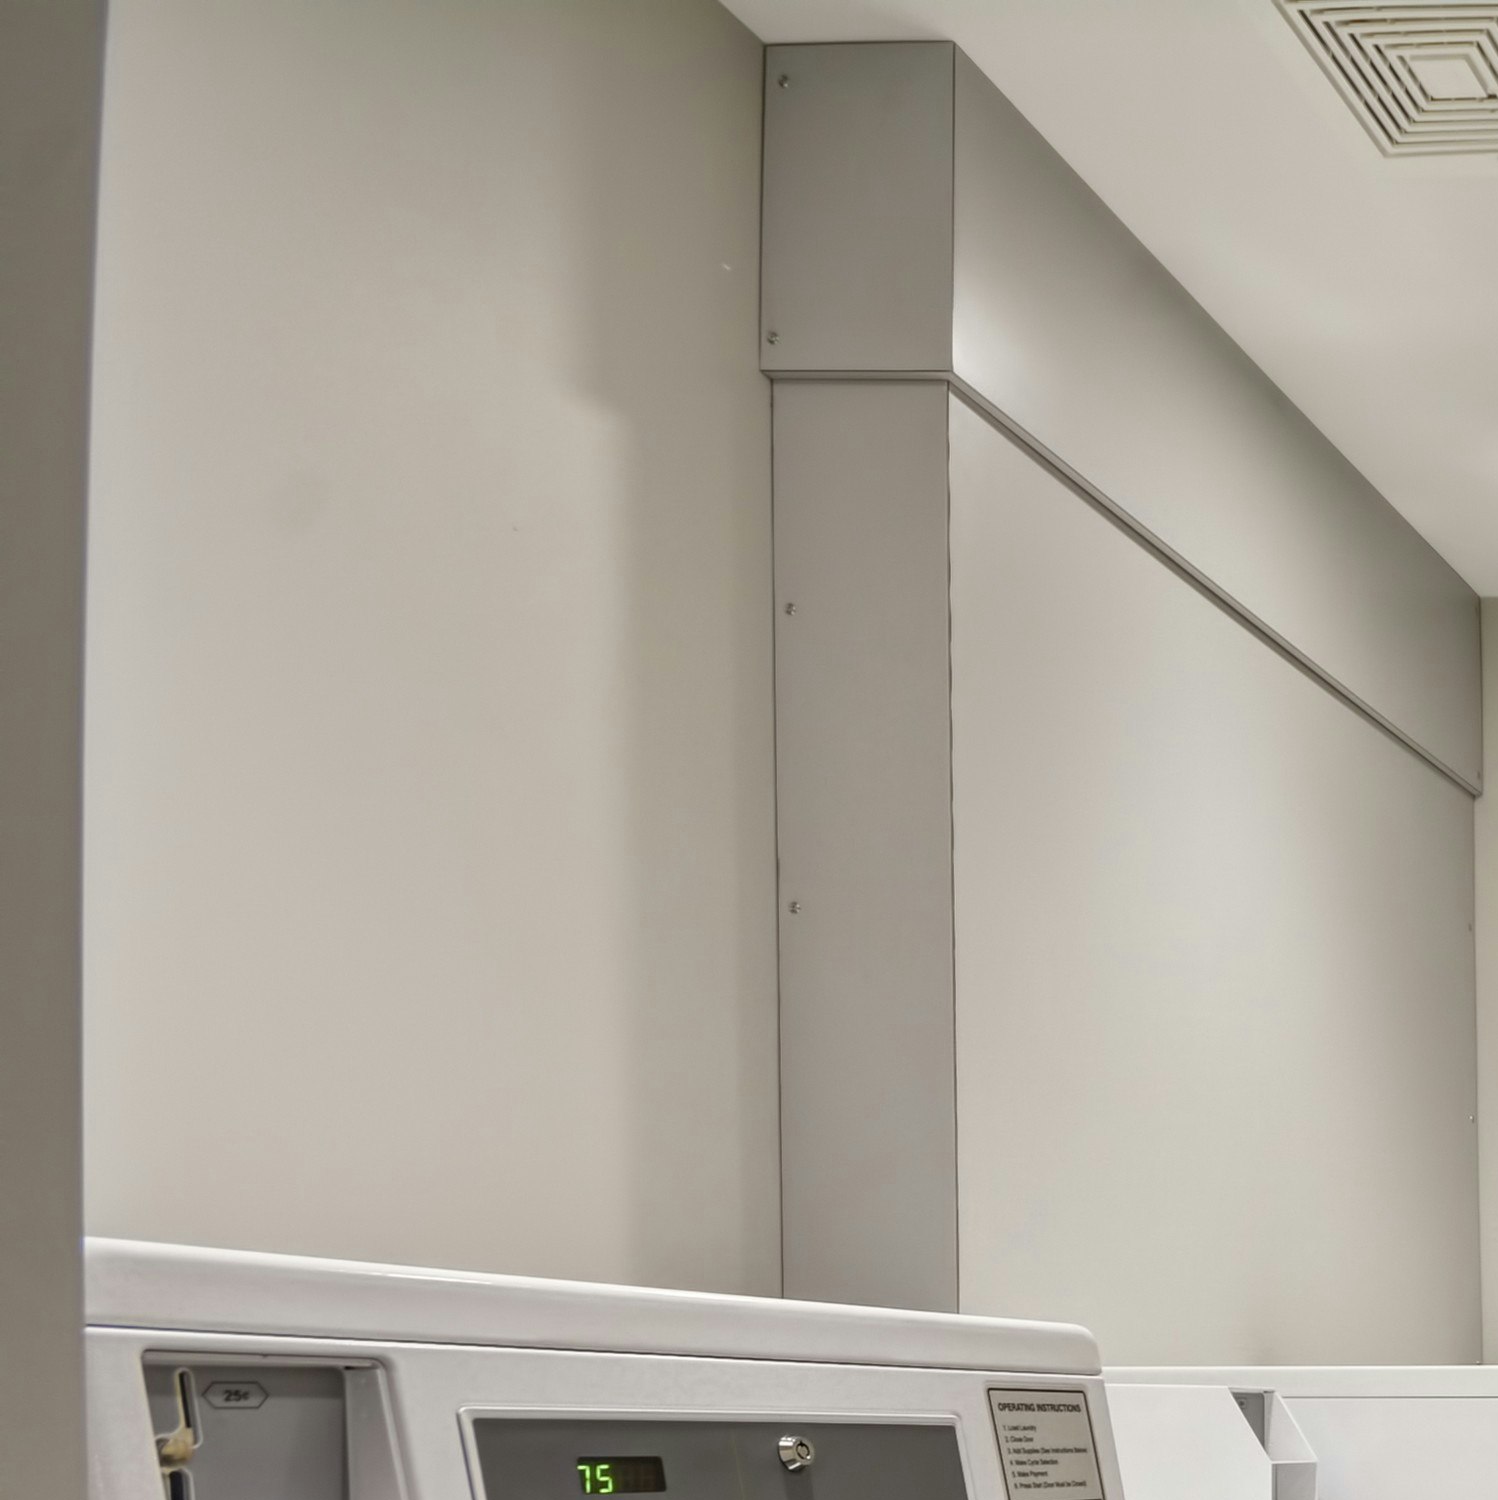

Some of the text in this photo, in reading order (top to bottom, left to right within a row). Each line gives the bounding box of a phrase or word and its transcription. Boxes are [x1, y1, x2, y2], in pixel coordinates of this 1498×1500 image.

[997, 1402, 1081, 1412] OPERATING INSTRUCTIONS
[577, 1464, 613, 1494] 75
